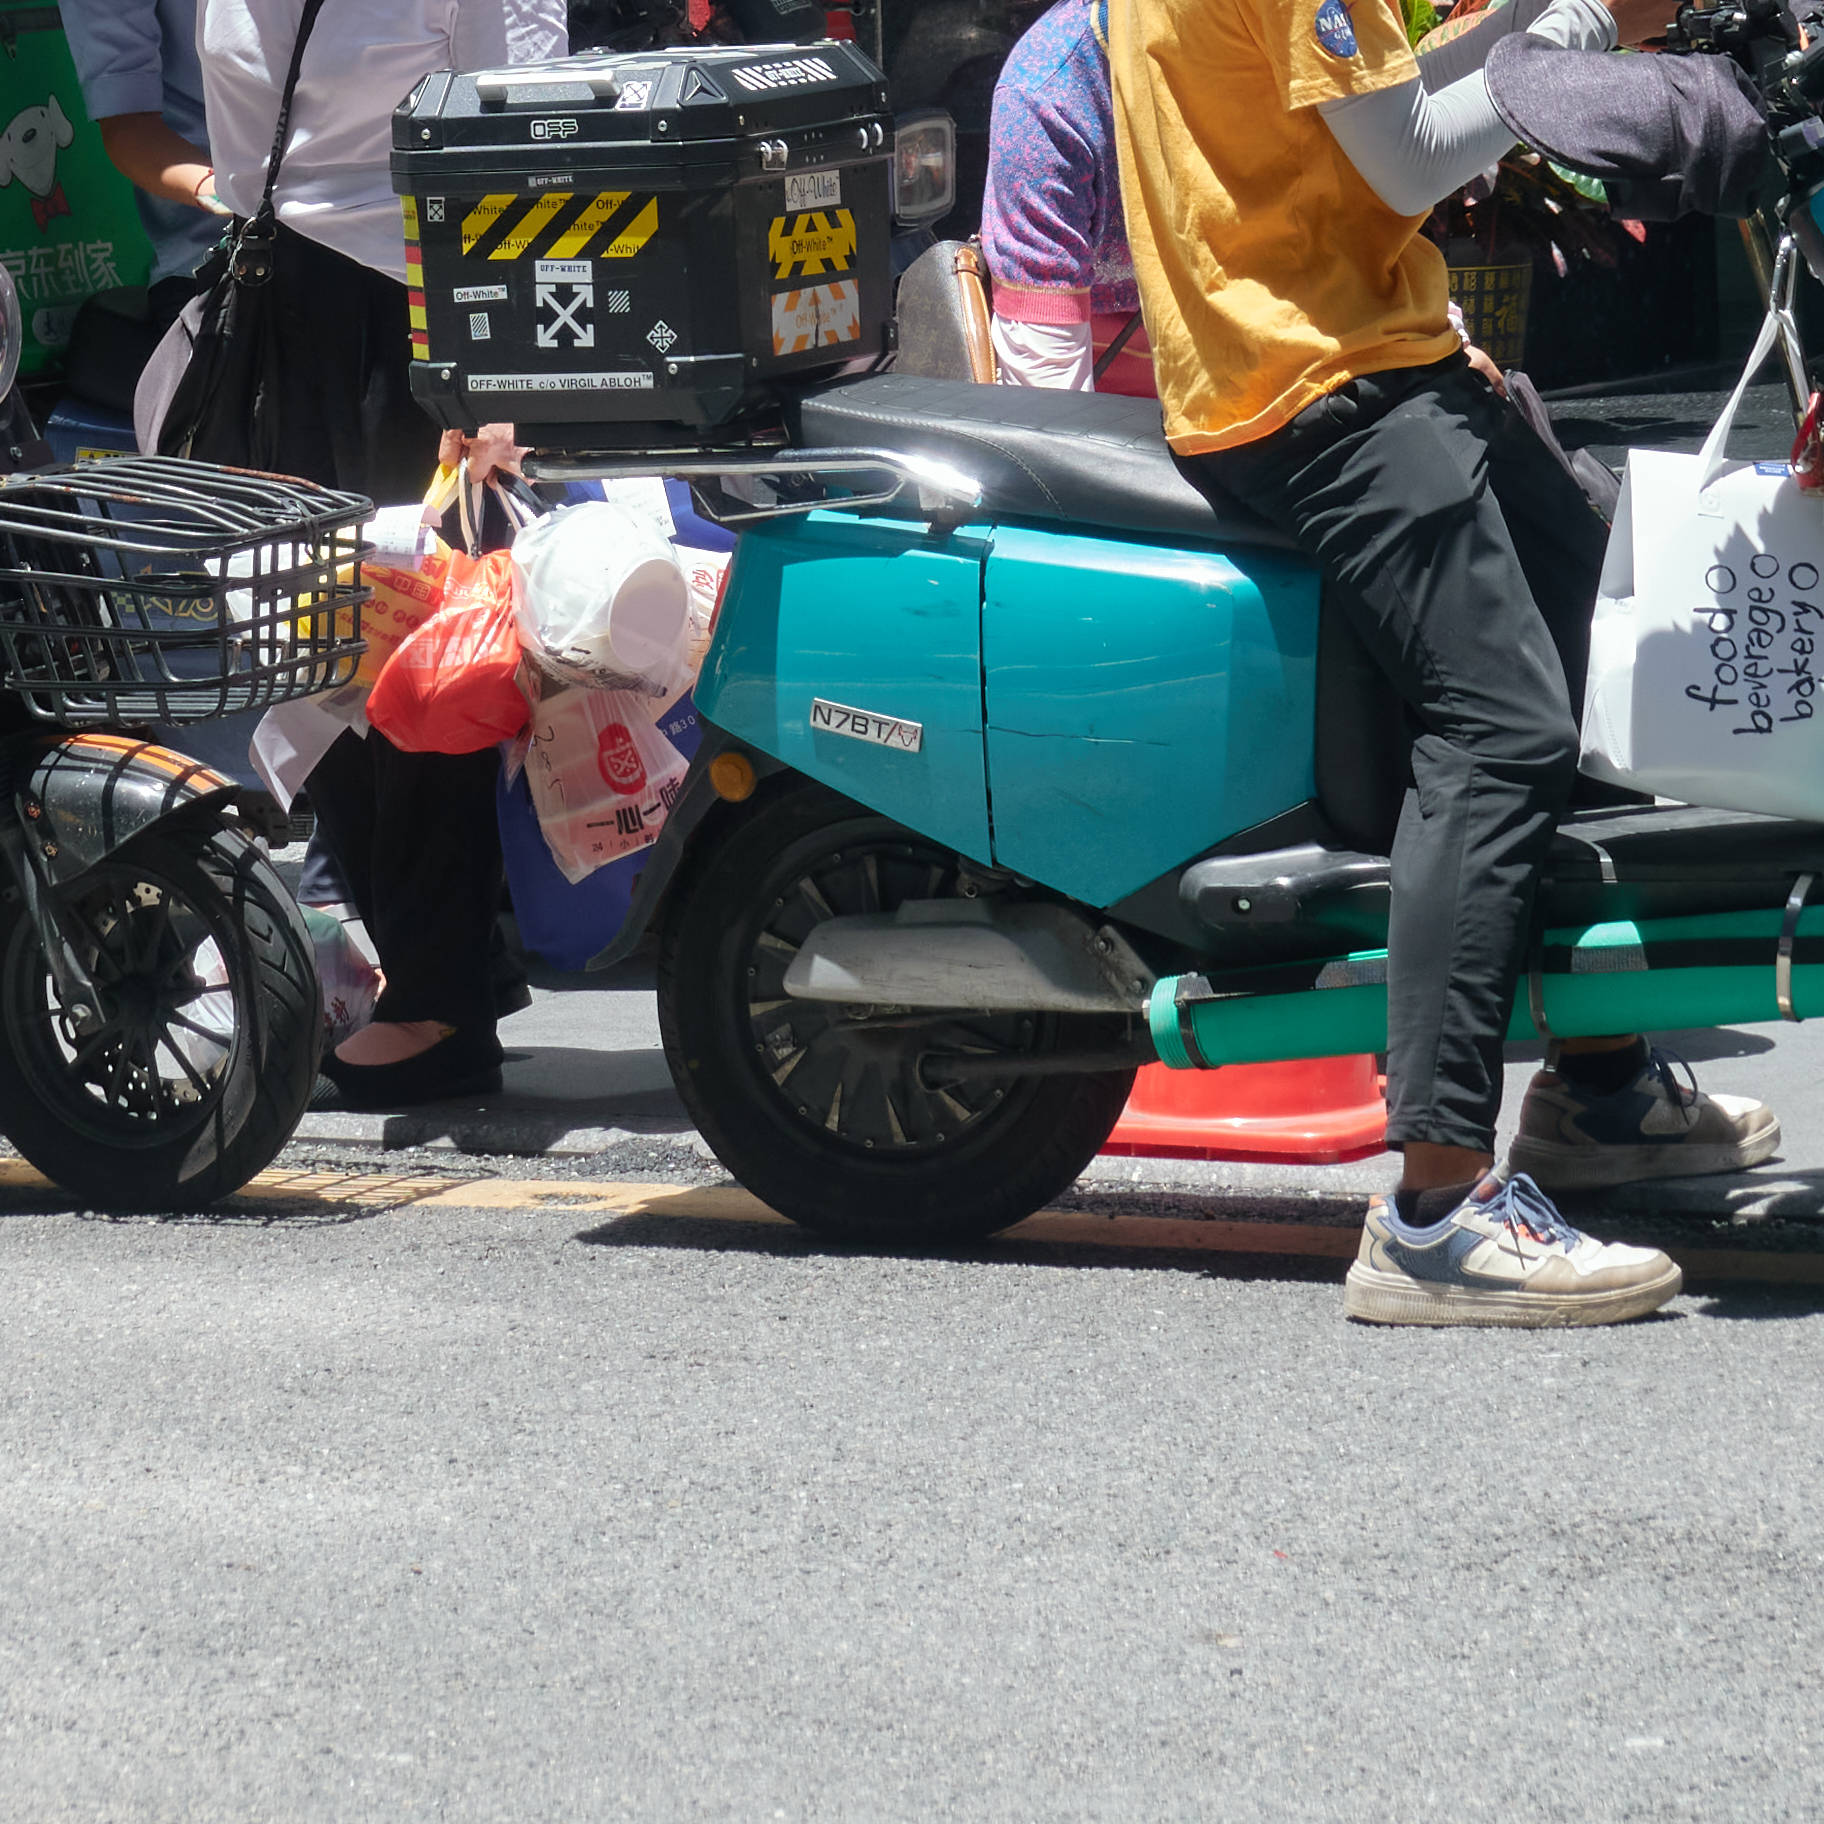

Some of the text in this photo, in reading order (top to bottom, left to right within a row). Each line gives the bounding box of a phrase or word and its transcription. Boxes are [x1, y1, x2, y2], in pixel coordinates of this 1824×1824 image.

[530, 118, 578, 140] OFF
[540, 264, 587, 273] OFF-WHITE
[470, 379, 533, 390] OFF-WHITE
[539, 380, 556, 389] c/o
[559, 378, 597, 389] VIRGIL
[1685, 608, 1739, 711] food
[1732, 586, 1785, 735] beverage
[1776, 599, 1824, 723] bakery
